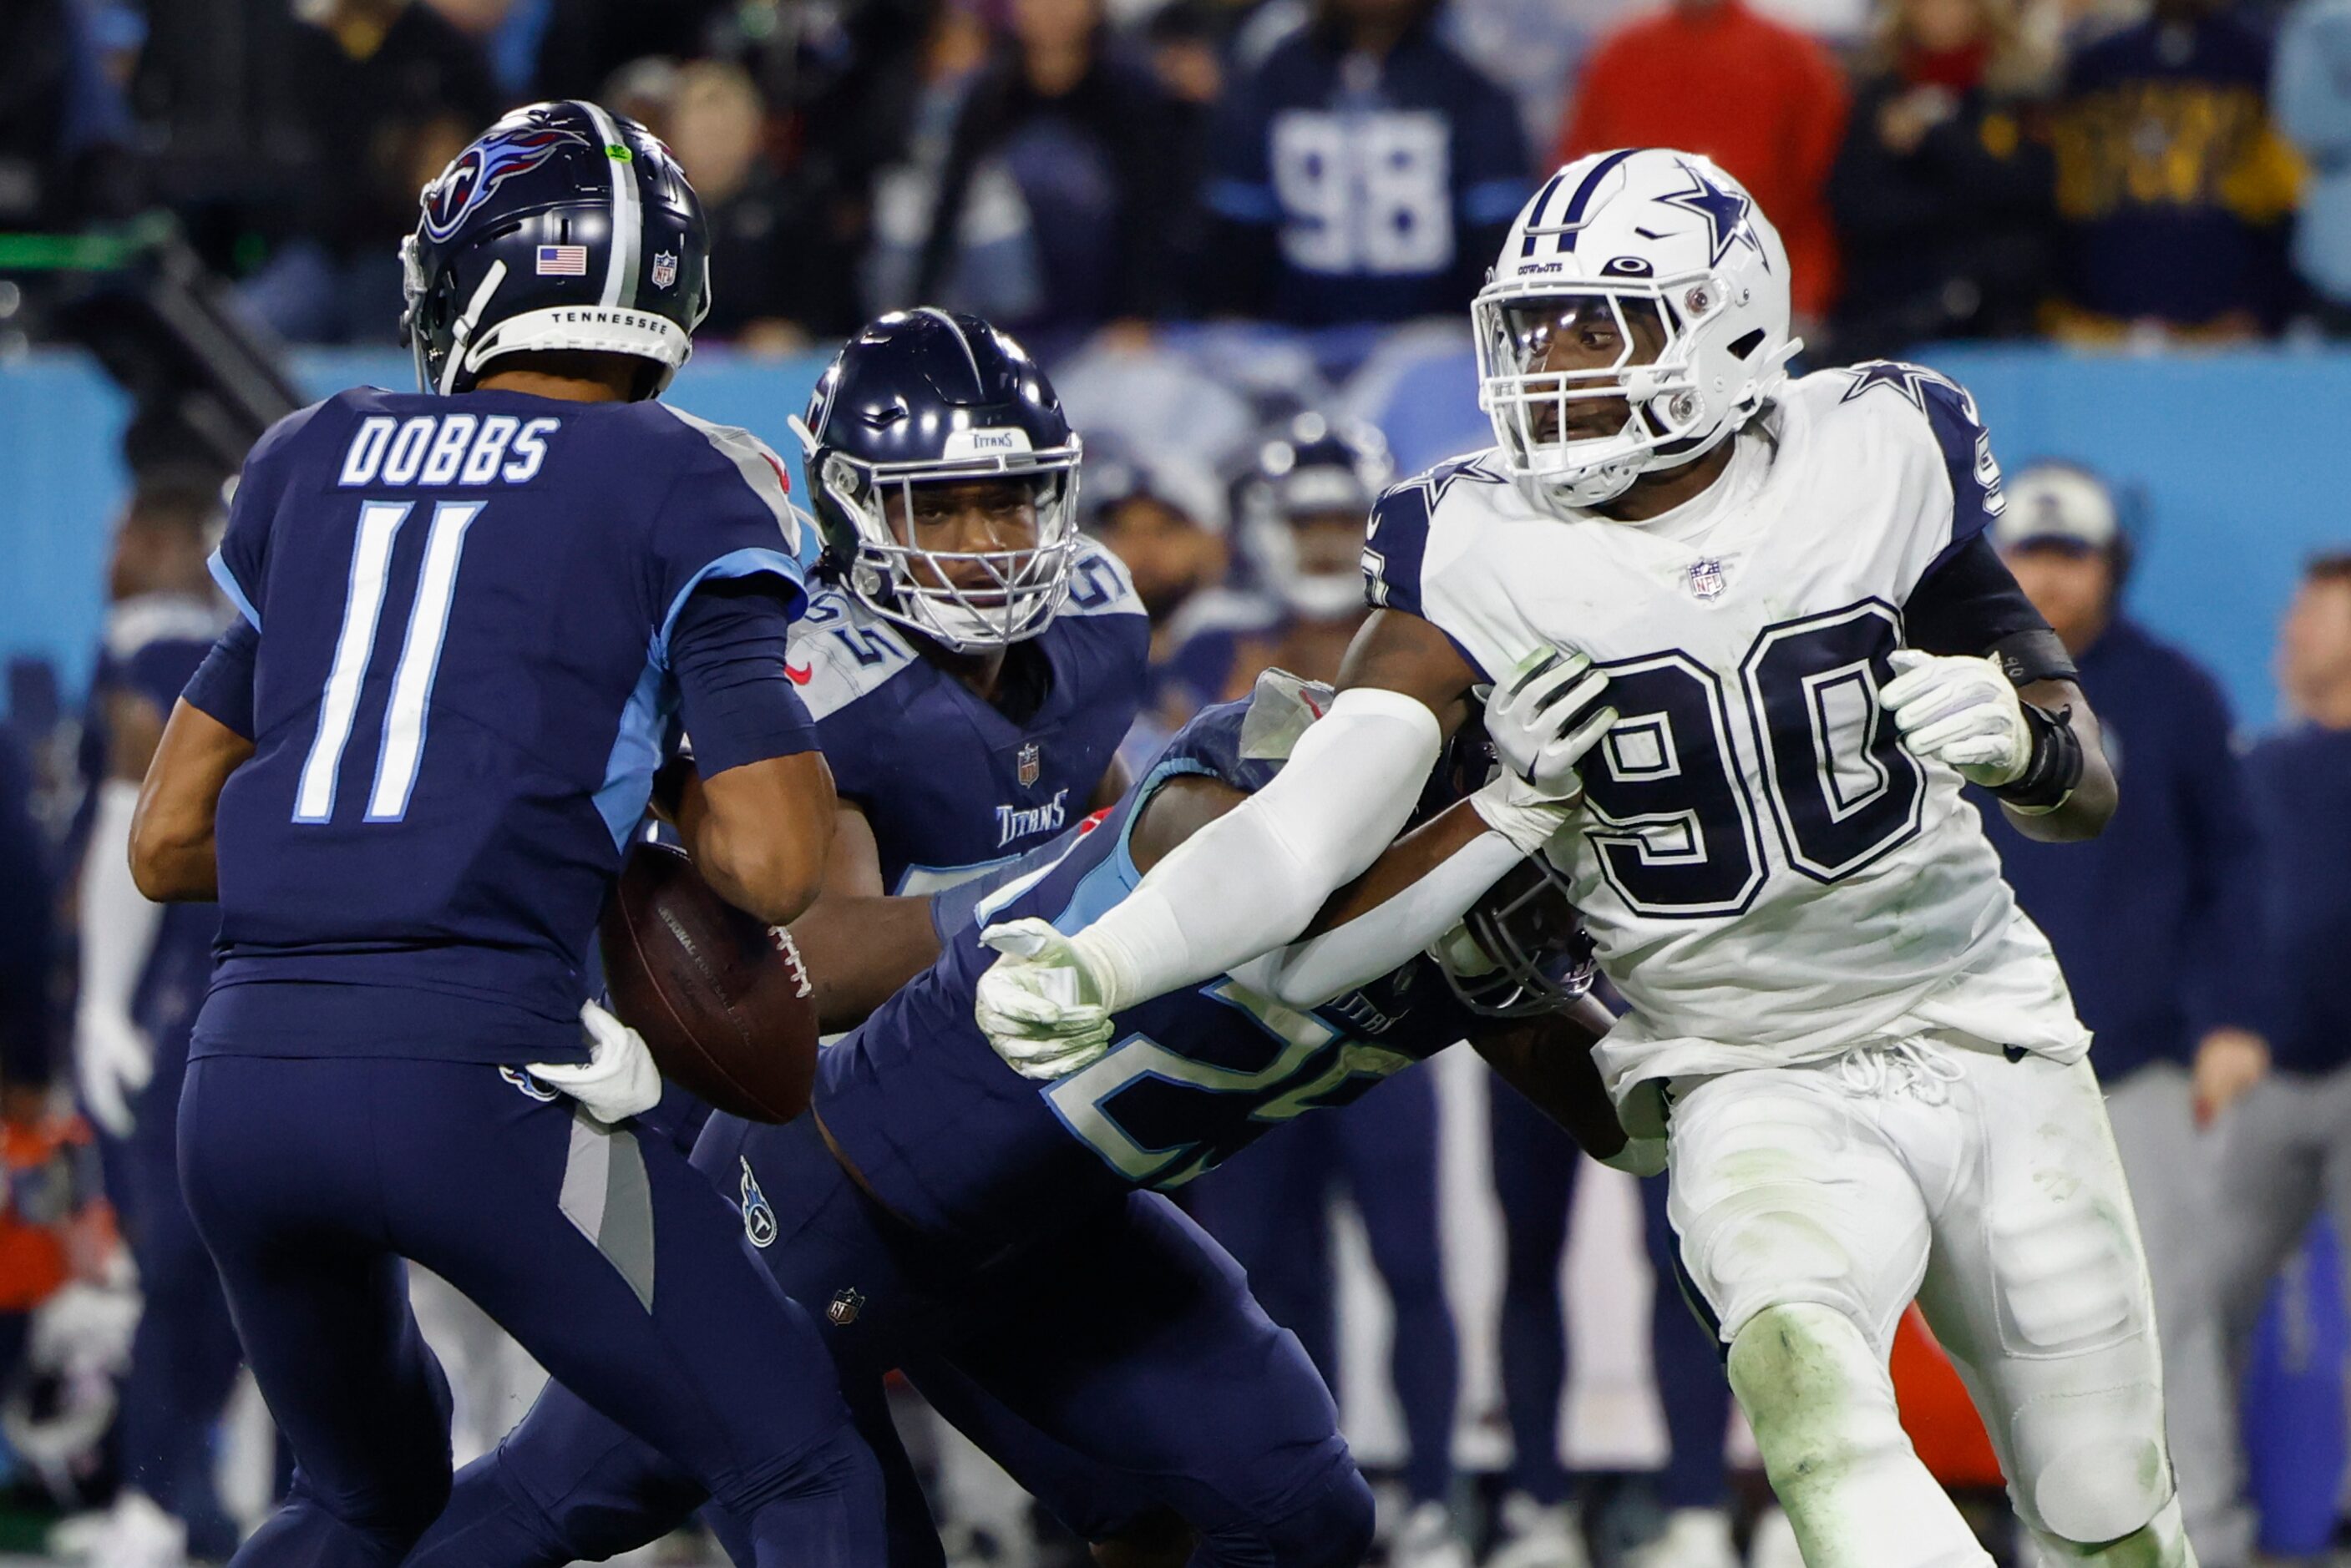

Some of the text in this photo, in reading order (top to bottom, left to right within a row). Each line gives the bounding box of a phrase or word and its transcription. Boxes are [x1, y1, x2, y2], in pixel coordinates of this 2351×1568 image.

[1272, 109, 1456, 276] 98
[656, 267, 673, 283] NFL
[1518, 262, 1563, 276] COWBOYS
[551, 312, 667, 335] TENNESSEE
[337, 414, 561, 487] DOBBS
[971, 432, 1013, 449] TITANS
[1695, 574, 1722, 593] NFL
[291, 499, 489, 825] 11
[1582, 594, 1927, 919] 90
[996, 787, 1070, 849] TITANS
